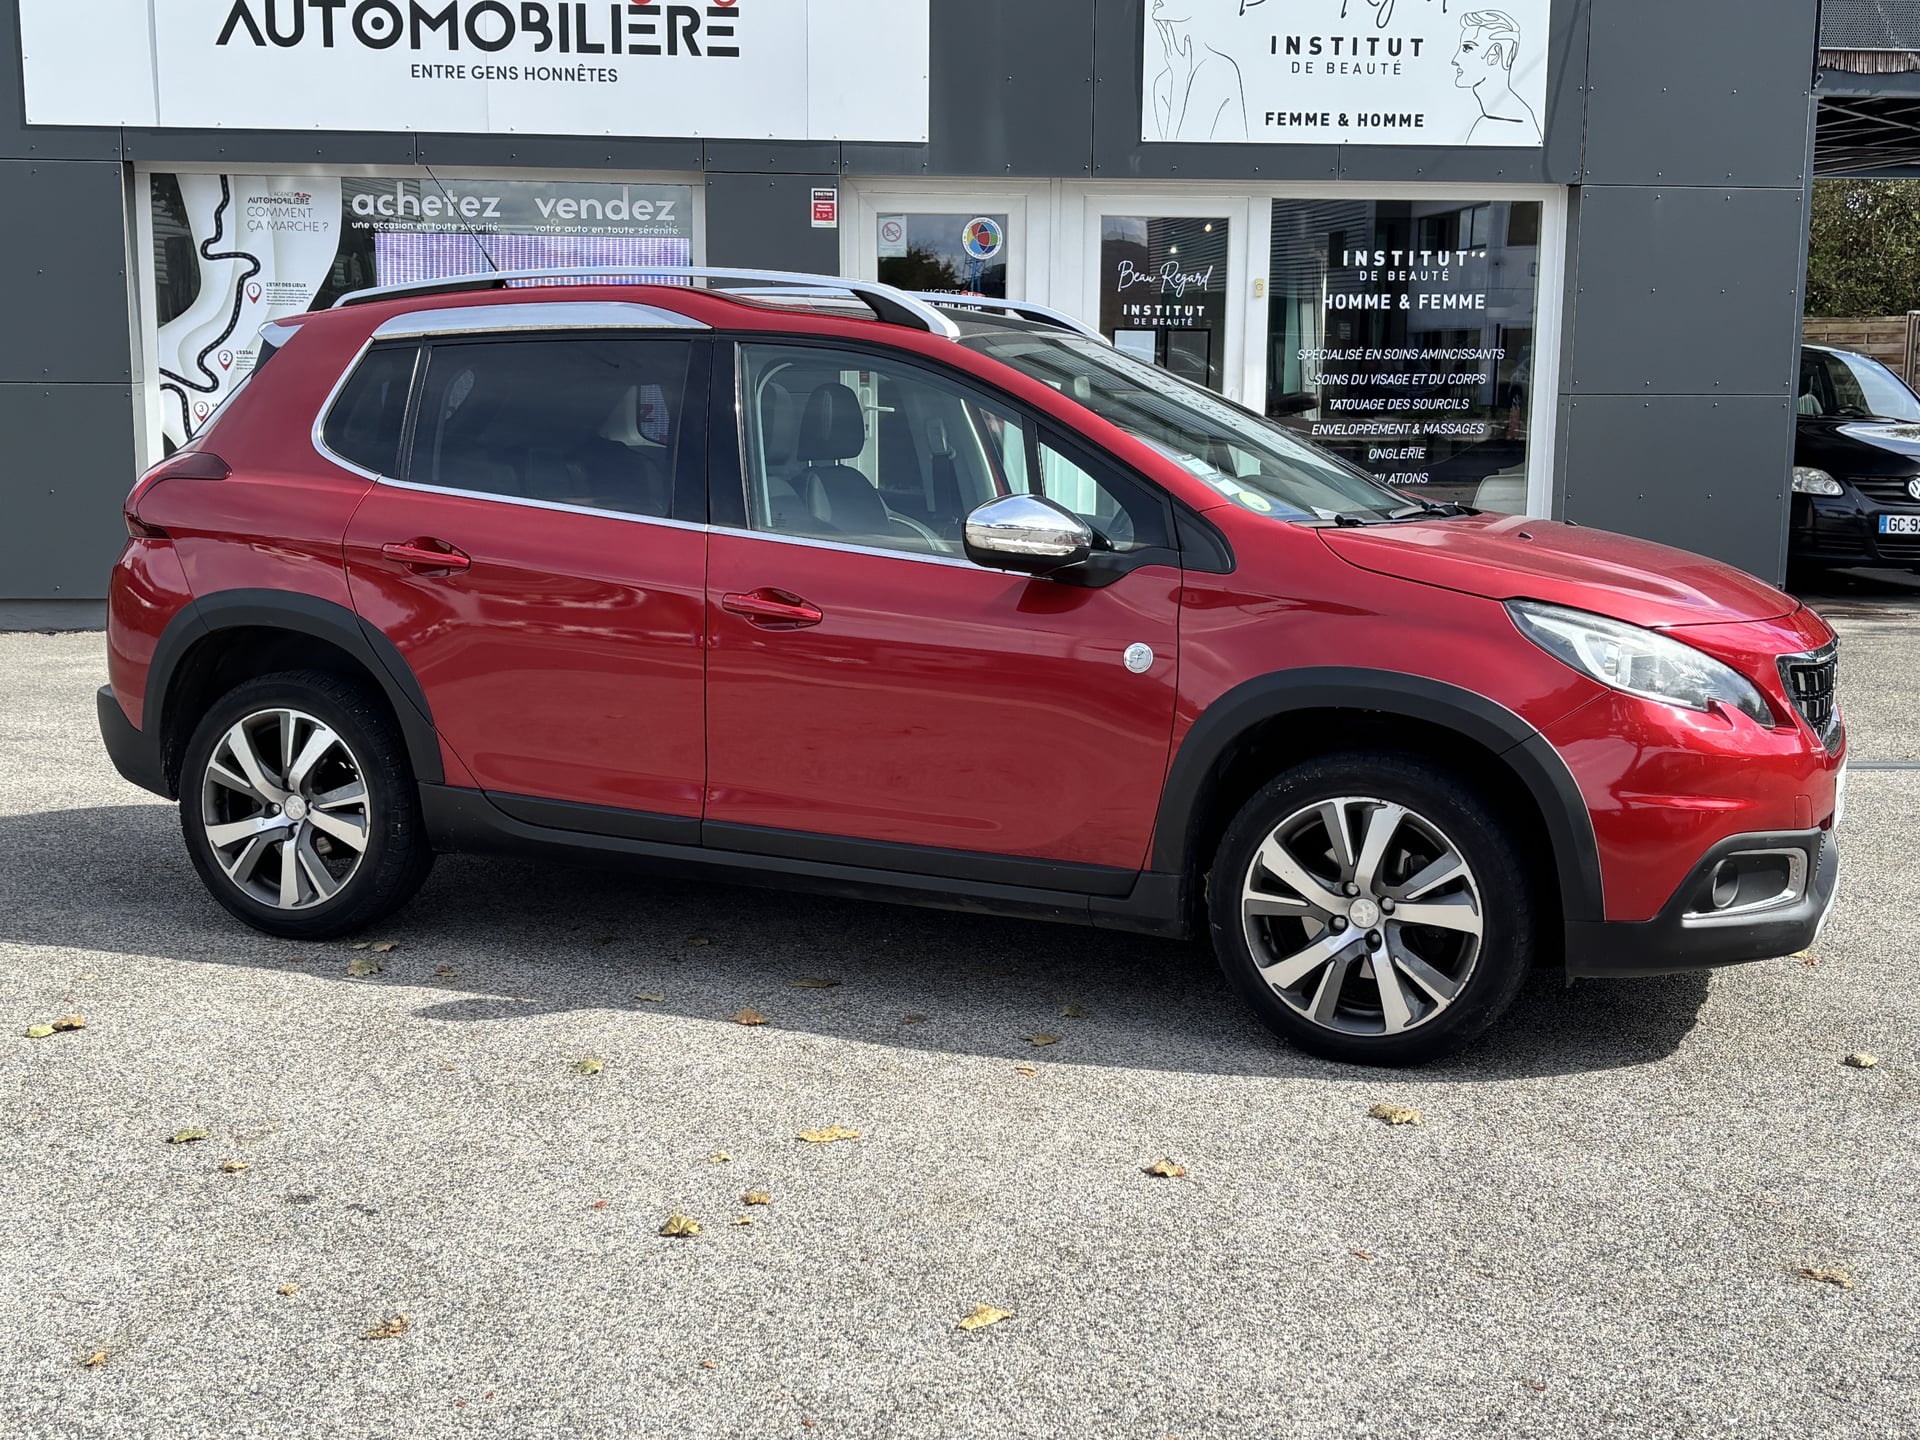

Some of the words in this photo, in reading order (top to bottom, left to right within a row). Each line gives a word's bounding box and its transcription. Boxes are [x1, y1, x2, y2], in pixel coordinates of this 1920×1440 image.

[1270, 35, 1424, 57] INSTITUT
[411, 64, 466, 79] ENTRE
[471, 65, 519, 80] GENS
[524, 63, 618, 83] HONNÊTES
[1291, 61, 1314, 74] DE
[1326, 60, 1402, 75] BEAUTÉ
[1265, 112, 1331, 127] FEMME
[1338, 112, 1350, 127] &
[1357, 113, 1424, 128] HOMME
[351, 181, 501, 218] achetez
[534, 185, 676, 221] vendez
[246, 206, 314, 218] COMMENT
[246, 219, 264, 232] ÇA
[267, 220, 320, 232] MARCHE
[322, 221, 329, 232] ?
[351, 221, 370, 229] une
[373, 222, 414, 230] occasion
[431, 222, 457, 230] toute
[534, 224, 562, 233] votre
[564, 225, 588, 233] auto
[591, 226, 603, 234] en
[607, 225, 635, 234] toute
[1342, 250, 1468, 267] INSTITUT
[1117, 260, 1156, 292] Beau
[1160, 261, 1213, 297] Regard
[1359, 270, 1378, 281] DE
[1387, 268, 1449, 281] BEAUTÉ
[1322, 294, 1391, 310] HOMME
[1399, 294, 1410, 310] &
[1418, 294, 1486, 310] FEMME
[1123, 303, 1205, 317] INSTITUT
[1133, 318, 1147, 326] DE
[1152, 317, 1193, 326] BEAUTÉ
[1297, 346, 1364, 360] SPÉCIALISÉ
[1365, 348, 1383, 360] EN
[1383, 348, 1419, 360] SOINS
[1419, 348, 1505, 360] AMINCISSANTS
[1313, 374, 1349, 386] SOINS
[1350, 374, 1370, 385] DU
[1370, 374, 1410, 385] VISAGE
[1411, 374, 1428, 385] ET
[1428, 374, 1447, 385] DU
[1447, 374, 1487, 385] CORPS
[1329, 399, 1386, 410] TATOUAGE
[1387, 399, 1411, 410] DES
[1412, 398, 1470, 410] SOURCILS
[1311, 423, 1411, 435] ENVELOPPEMENT
[1412, 424, 1420, 435] &
[1422, 423, 1485, 435] MASSAGES
[1368, 448, 1427, 460] ONGLERIE
[1889, 517, 1920, 532] GC-9
